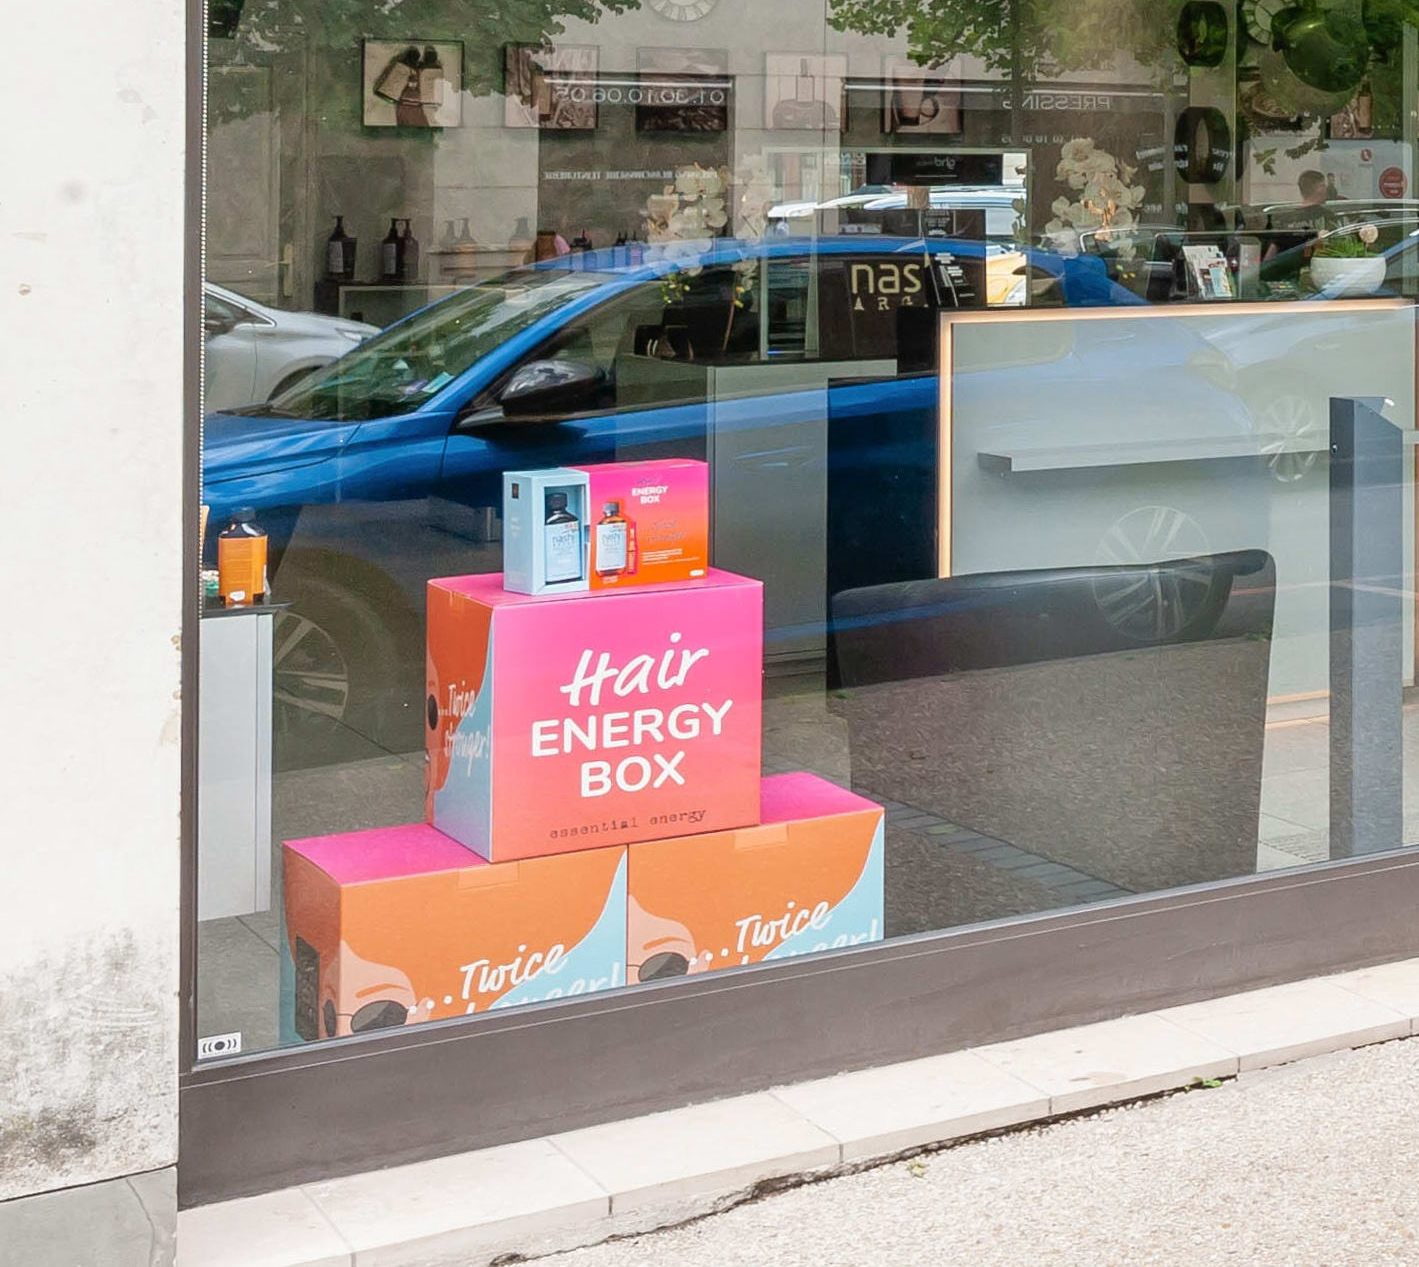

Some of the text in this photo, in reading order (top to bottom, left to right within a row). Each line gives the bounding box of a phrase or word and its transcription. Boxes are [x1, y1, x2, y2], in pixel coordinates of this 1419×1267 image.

[851, 263, 922, 294] nas
[632, 485, 669, 497] ENERGY
[640, 494, 660, 505] BOX
[560, 632, 709, 708] Hair
[531, 699, 733, 758] ENERGY
[580, 751, 686, 798] BOX
[549, 807, 708, 840] essential energy
